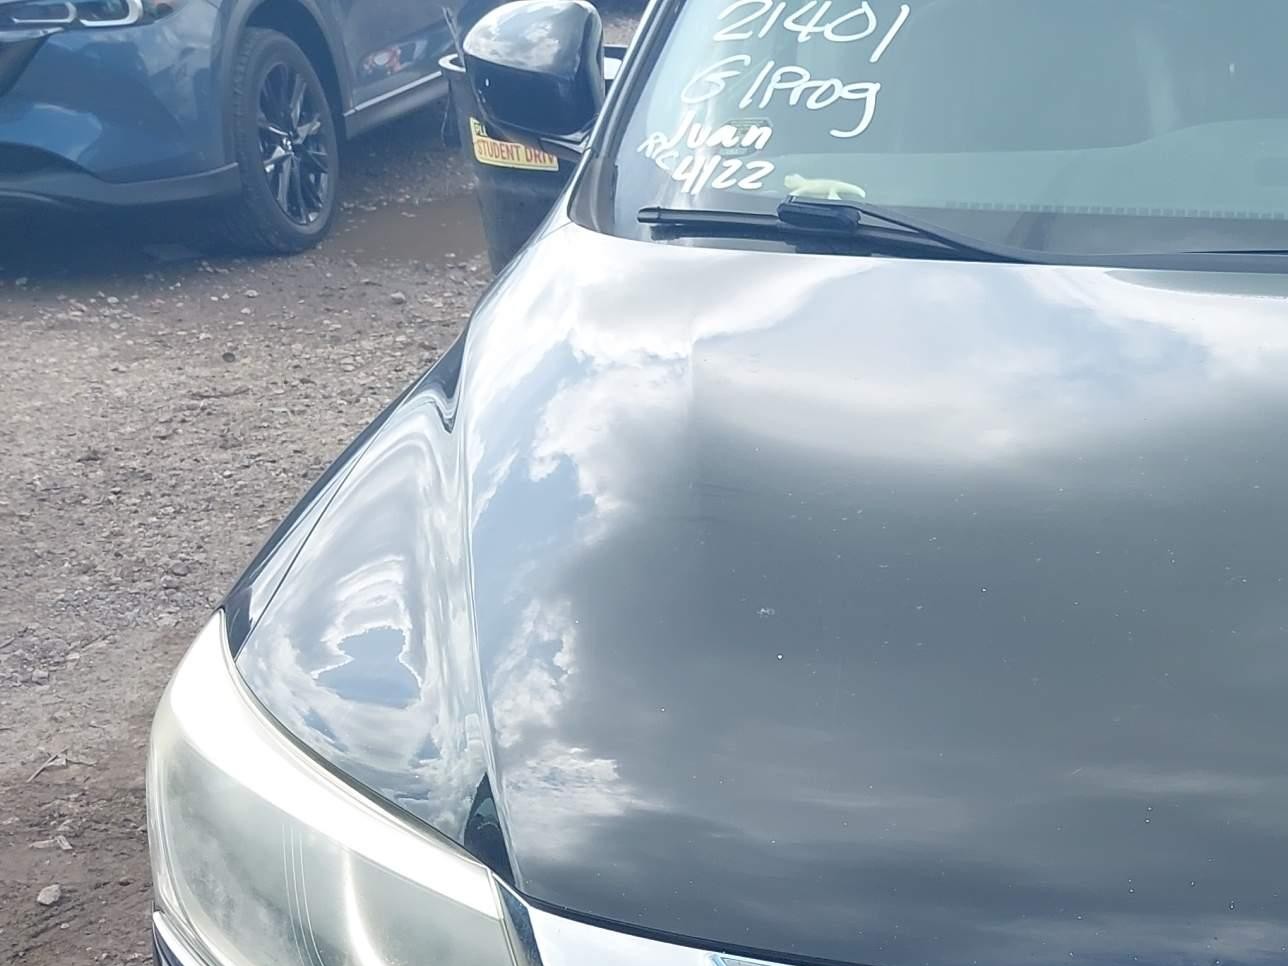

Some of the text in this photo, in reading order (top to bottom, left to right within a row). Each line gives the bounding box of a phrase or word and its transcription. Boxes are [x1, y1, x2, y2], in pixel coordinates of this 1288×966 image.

[713, 0, 911, 63] 21401
[477, 139, 521, 161] STUDENT
[666, 110, 773, 150] Juan
